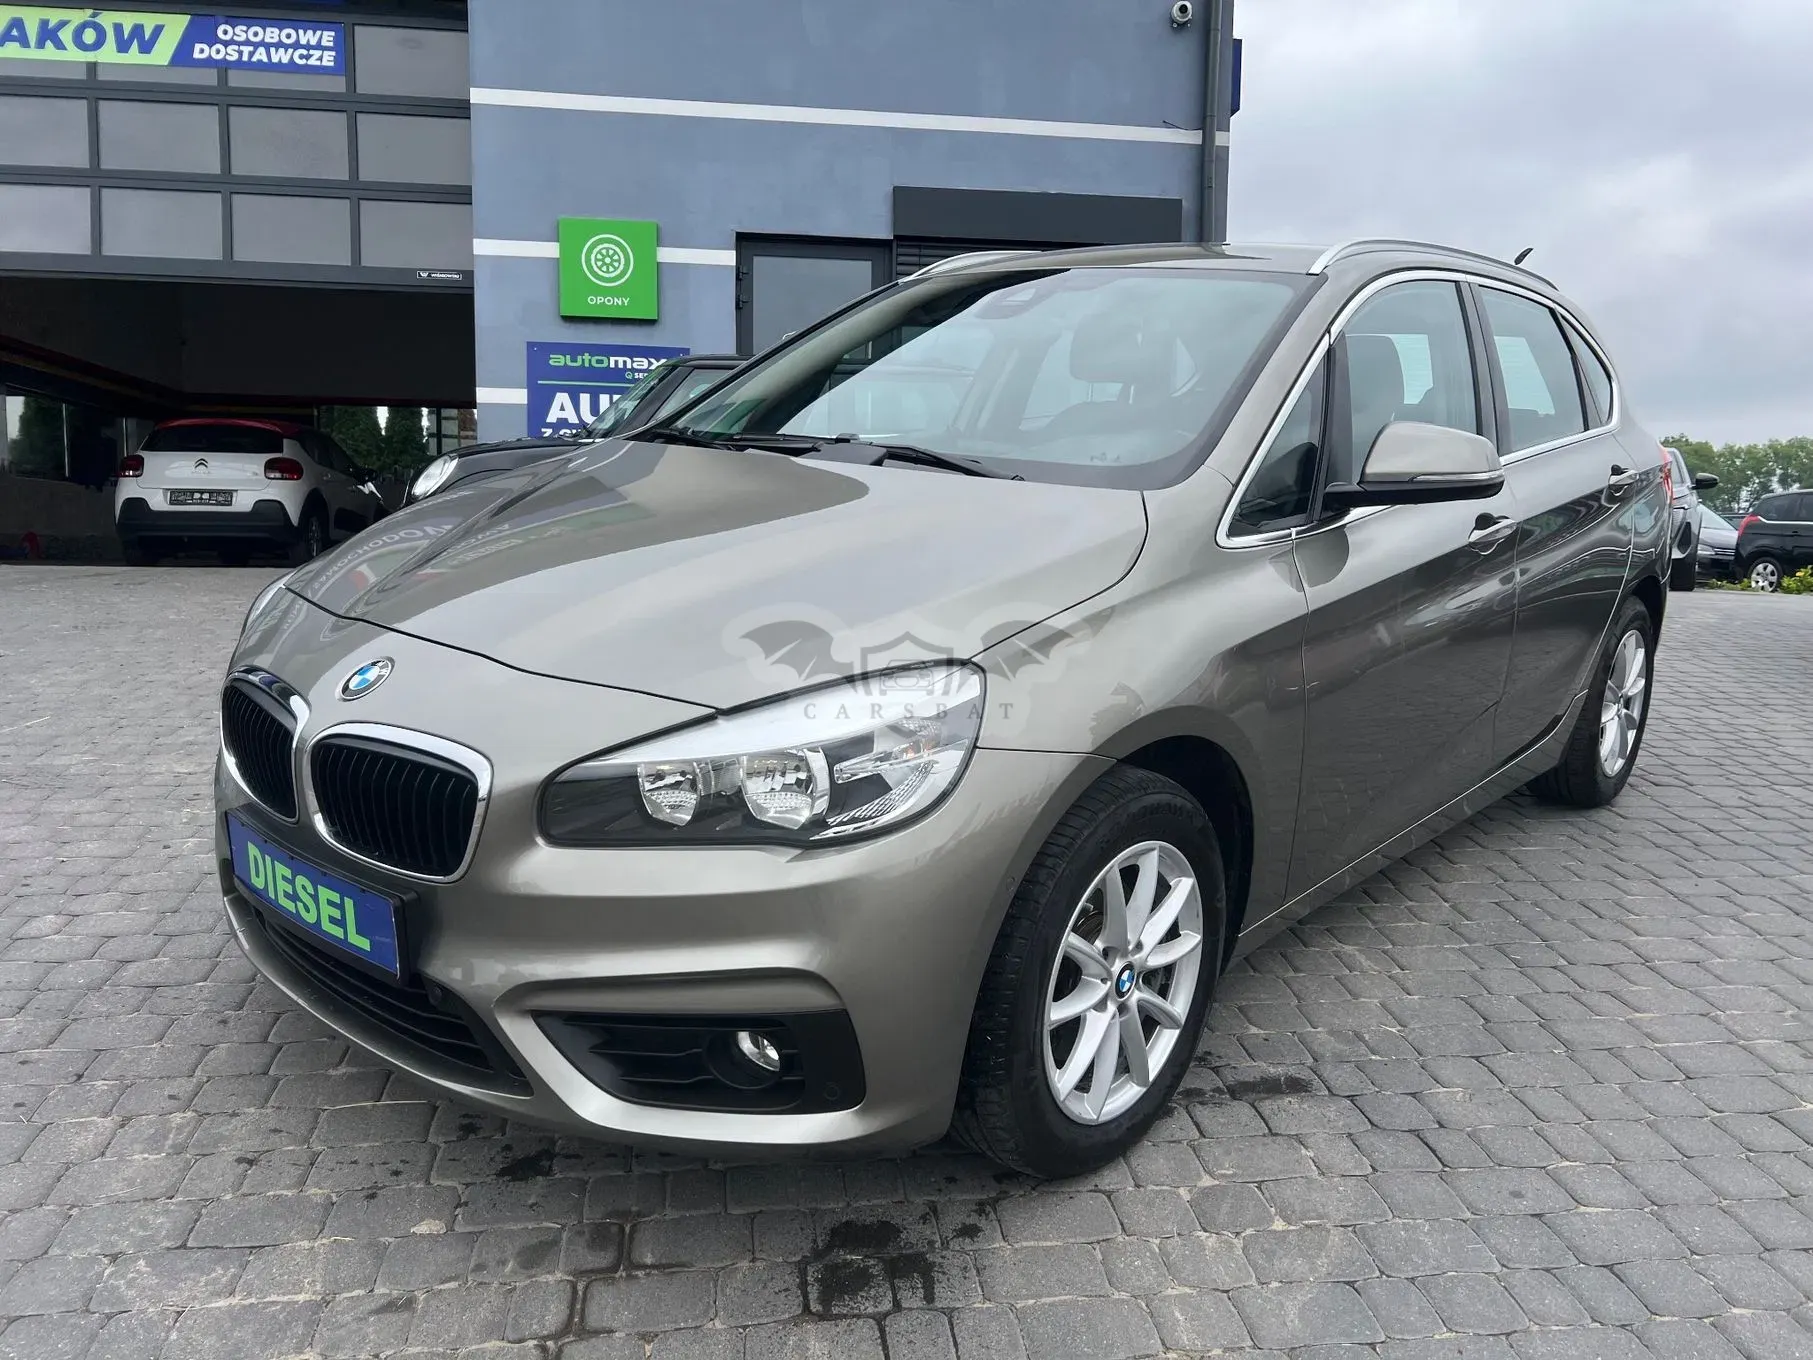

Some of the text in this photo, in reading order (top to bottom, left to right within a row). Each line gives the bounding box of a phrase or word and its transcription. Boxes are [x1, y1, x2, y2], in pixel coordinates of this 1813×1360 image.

[0, 12, 165, 54] AKÓW
[216, 24, 336, 47] OSOBOWE
[192, 43, 336, 67] DOSTAWCZE
[587, 295, 630, 306] OPONY
[549, 352, 668, 370] automax
[546, 392, 622, 425] AU
[247, 841, 371, 952] DIESEL
